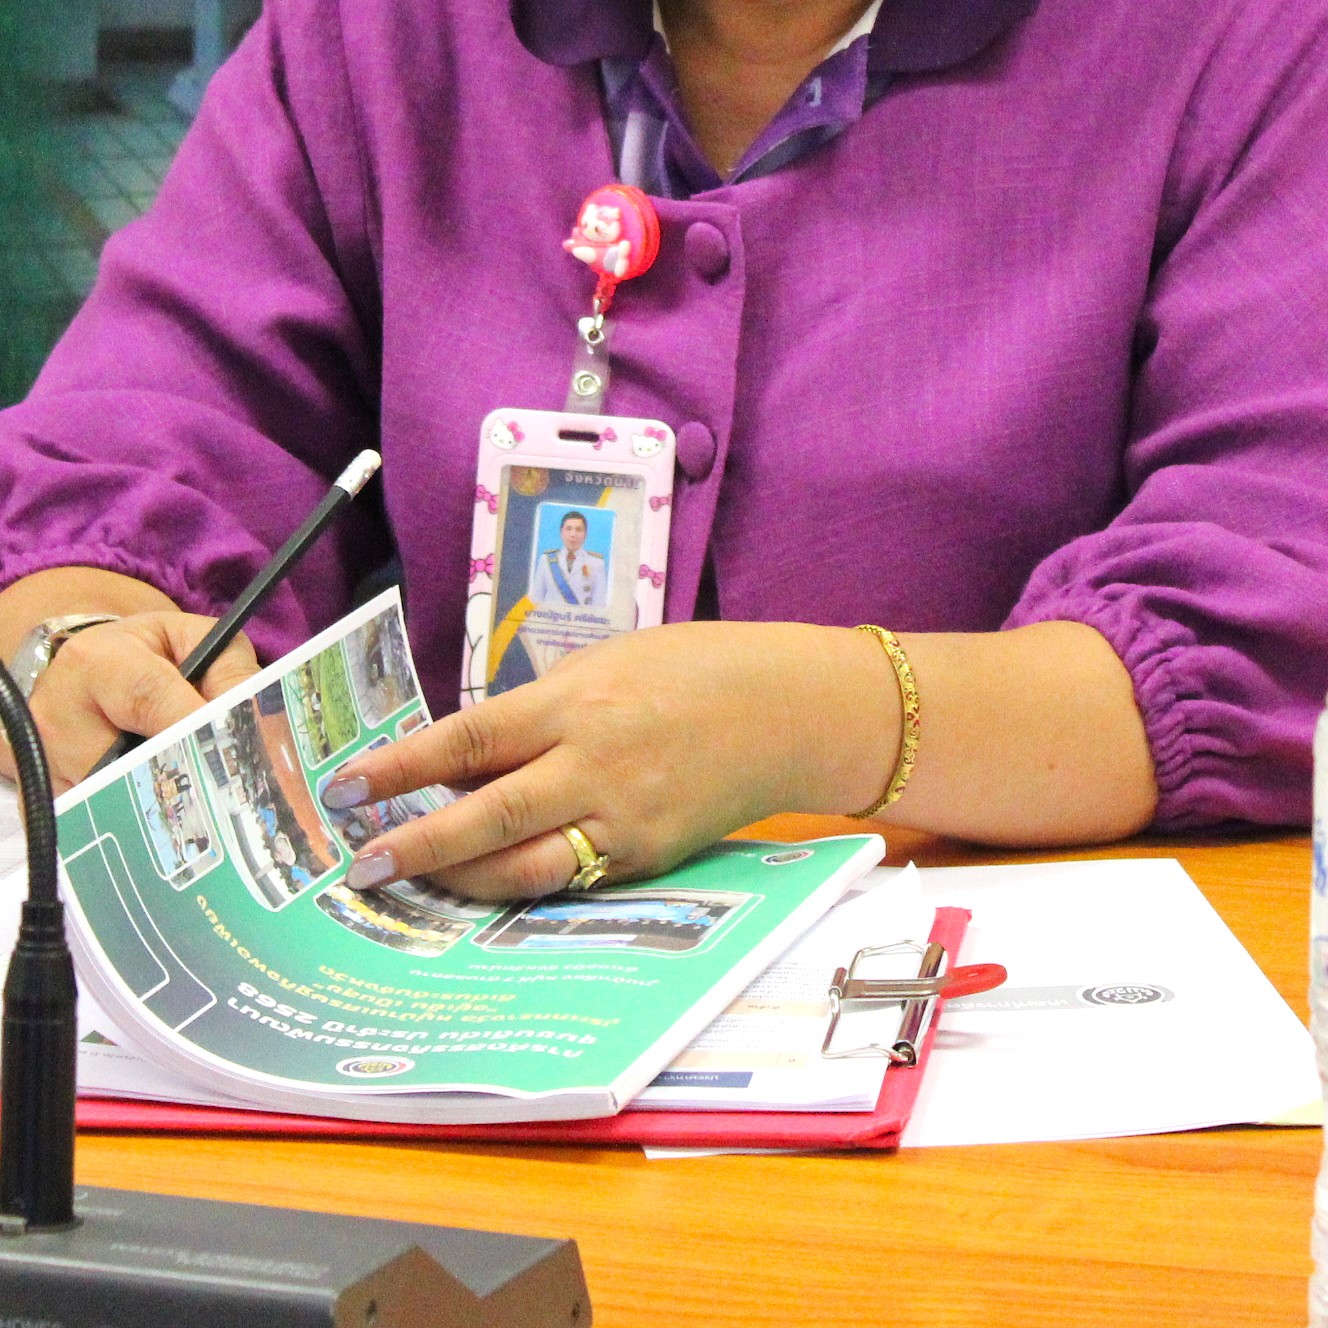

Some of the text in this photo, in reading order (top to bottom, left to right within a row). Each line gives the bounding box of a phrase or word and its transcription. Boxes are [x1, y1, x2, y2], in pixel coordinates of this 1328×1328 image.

[224, 996, 583, 1059] การคัดสรรกิจกรรมพัฒนา
[234, 981, 596, 1045] ชุมชนดีเด่น ประจำปี 2568
